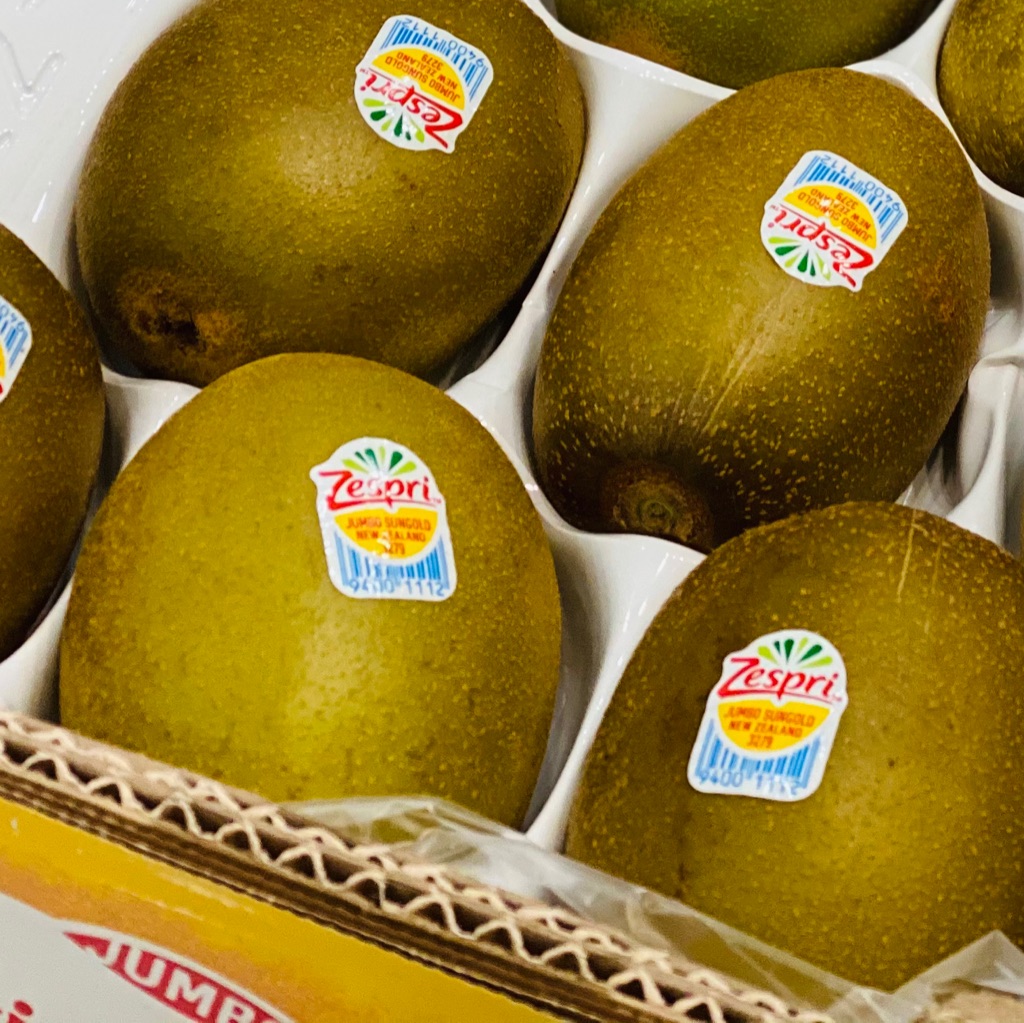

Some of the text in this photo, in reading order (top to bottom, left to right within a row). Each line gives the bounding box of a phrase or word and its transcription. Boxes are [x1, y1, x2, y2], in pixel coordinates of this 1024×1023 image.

[402, 18, 485, 68] 9400 1112
[421, 54, 444, 70] 3279
[385, 56, 460, 102] JUMBO SUNGOLD
[397, 52, 458, 90] NEW ZEALAND
[360, 68, 463, 149] Zespri
[821, 155, 901, 211] 9400 1112
[836, 192, 859, 210] 3279
[797, 192, 872, 242] JUMBO SUNGOLD
[811, 188, 871, 230] NEW ZEALAND
[768, 204, 874, 287] Zespri
[318, 471, 436, 511] Zespri
[356, 531, 425, 542] NEW EALAND
[384, 517, 431, 530] SUNGOLD
[383, 543, 405, 554] 279
[406, 581, 444, 596] 1112
[717, 658, 839, 704] Zespri
[724, 706, 816, 727] JUMBO SUNGOLD
[728, 720, 803, 737] NEW ZEALAND
[88, 939, 286, 1023] JUMB
